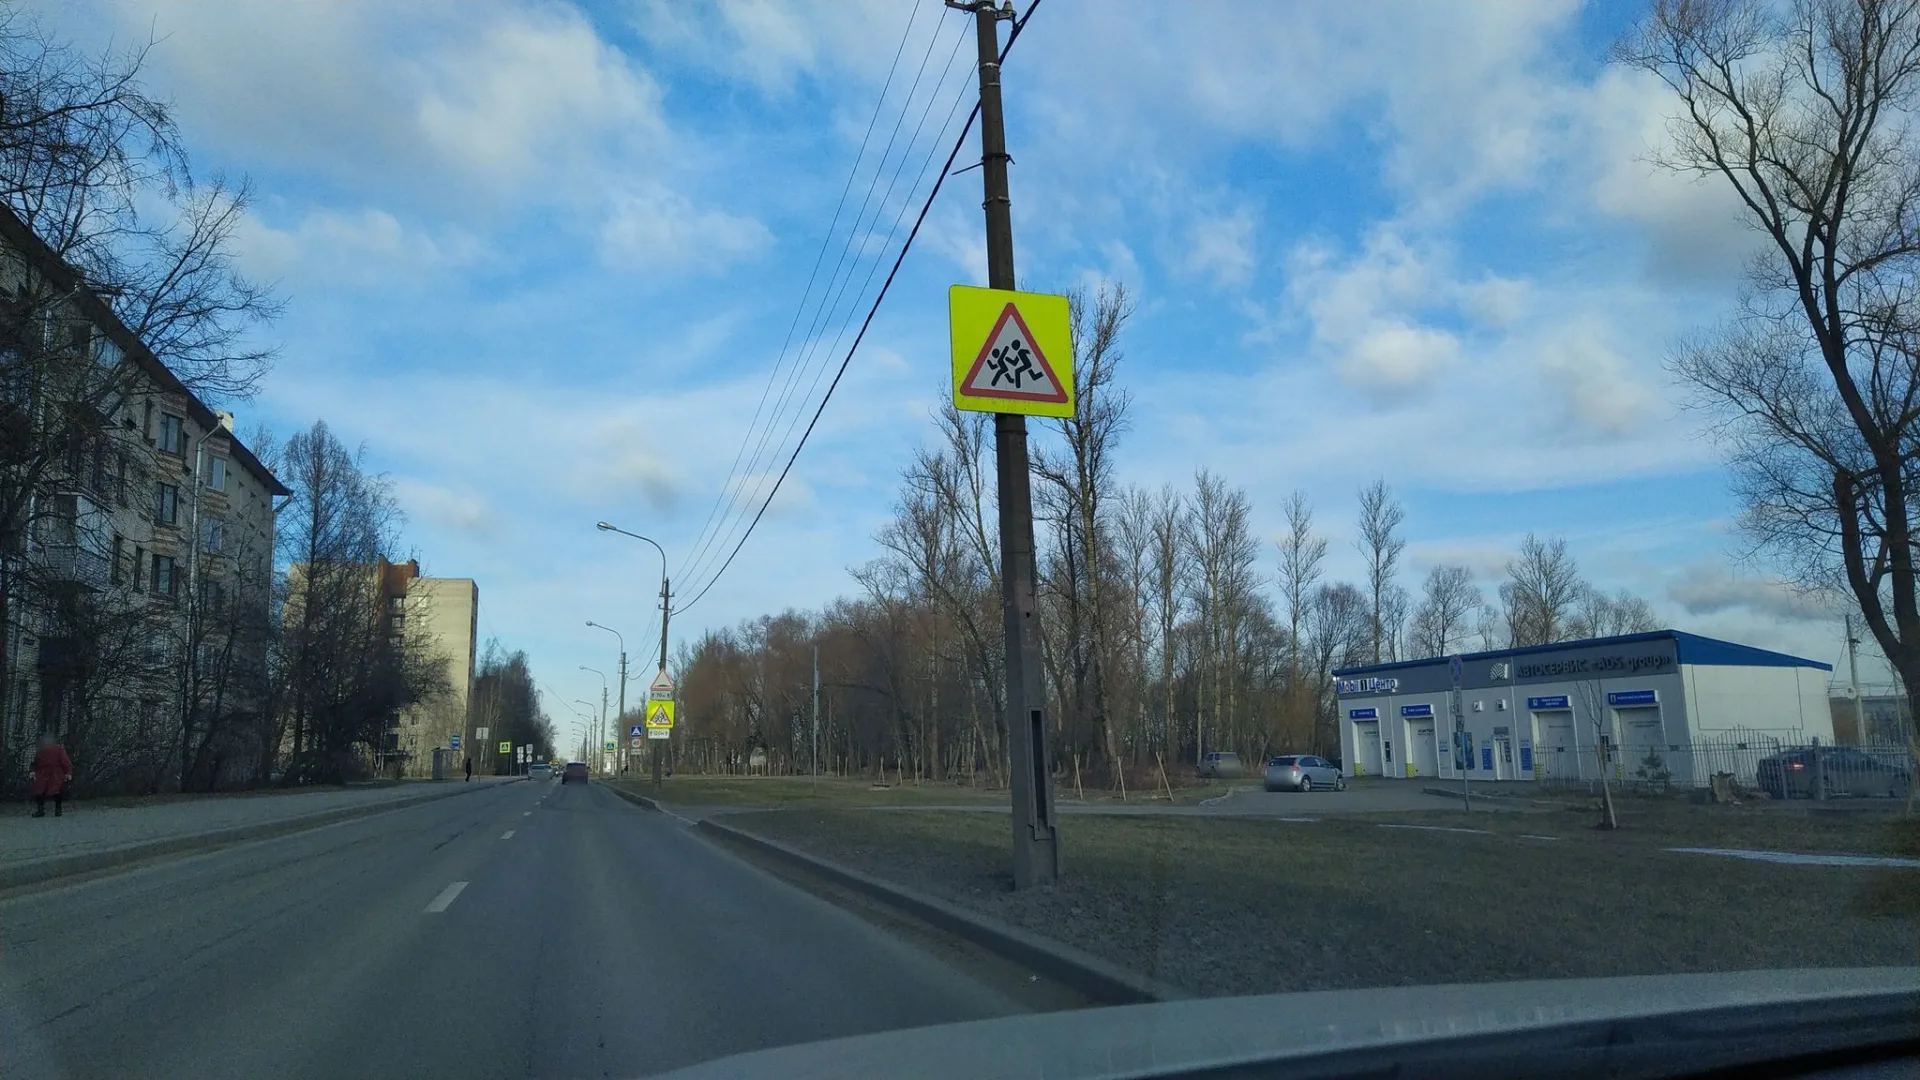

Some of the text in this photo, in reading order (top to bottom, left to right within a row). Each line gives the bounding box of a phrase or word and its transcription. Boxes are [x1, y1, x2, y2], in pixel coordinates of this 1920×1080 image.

[1518, 659, 1588, 677] АВТОСЕРВИС
[1338, 680, 1358, 693] Mobil
[1370, 677, 1395, 692] Центр
